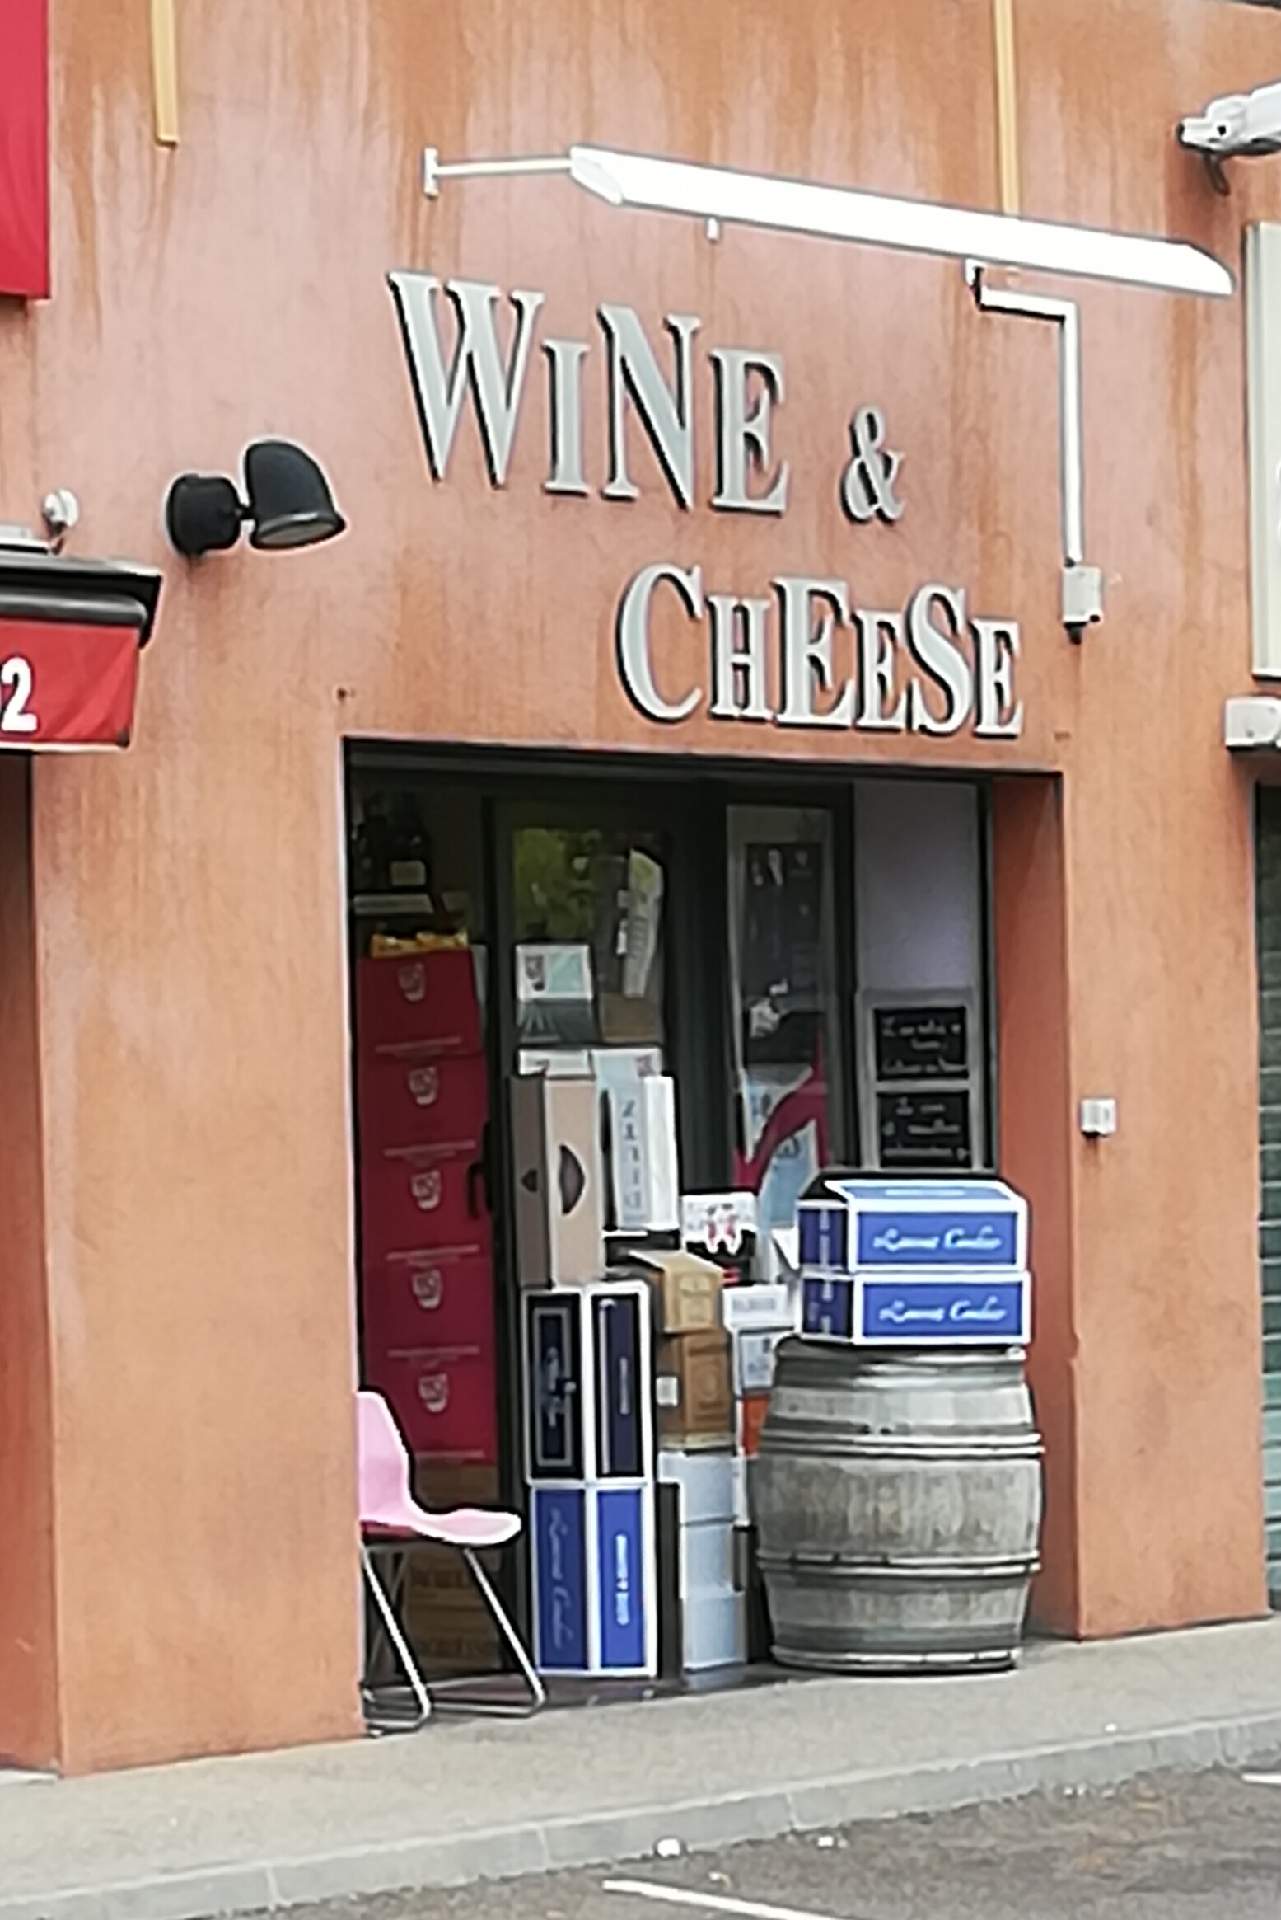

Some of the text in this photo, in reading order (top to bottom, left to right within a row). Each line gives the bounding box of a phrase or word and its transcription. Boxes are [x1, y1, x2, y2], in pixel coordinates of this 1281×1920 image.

[387, 271, 904, 523] WINE &
[1, 656, 38, 731] 2
[615, 563, 1022, 738] CHEESE
